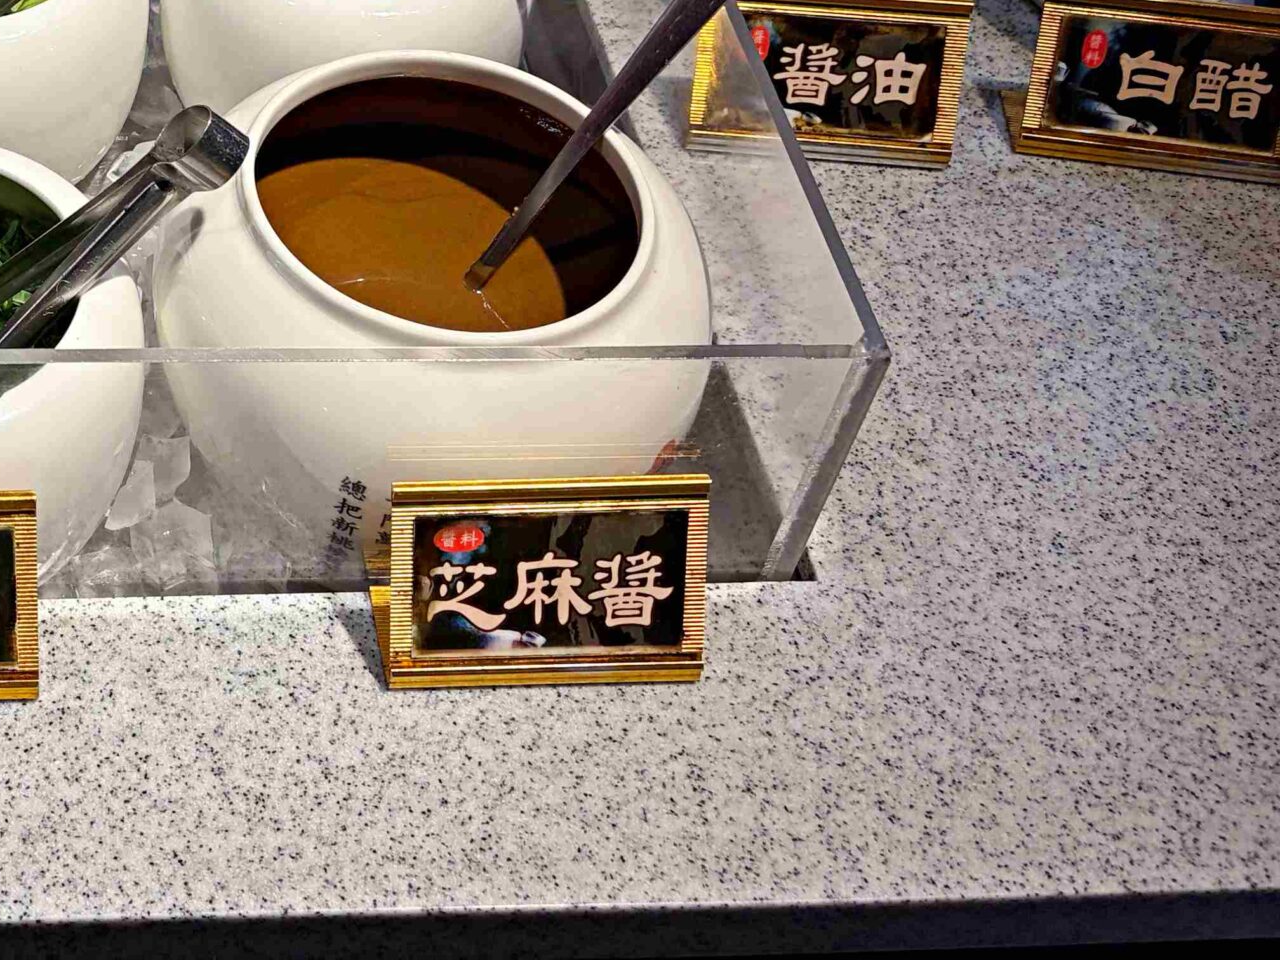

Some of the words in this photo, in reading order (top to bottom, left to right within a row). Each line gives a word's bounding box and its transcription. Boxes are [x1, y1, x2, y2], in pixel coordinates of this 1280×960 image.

[773, 42, 927, 106] 醬油
[1117, 49, 1273, 120] 白醋
[427, 550, 674, 631] 芝麻醬
